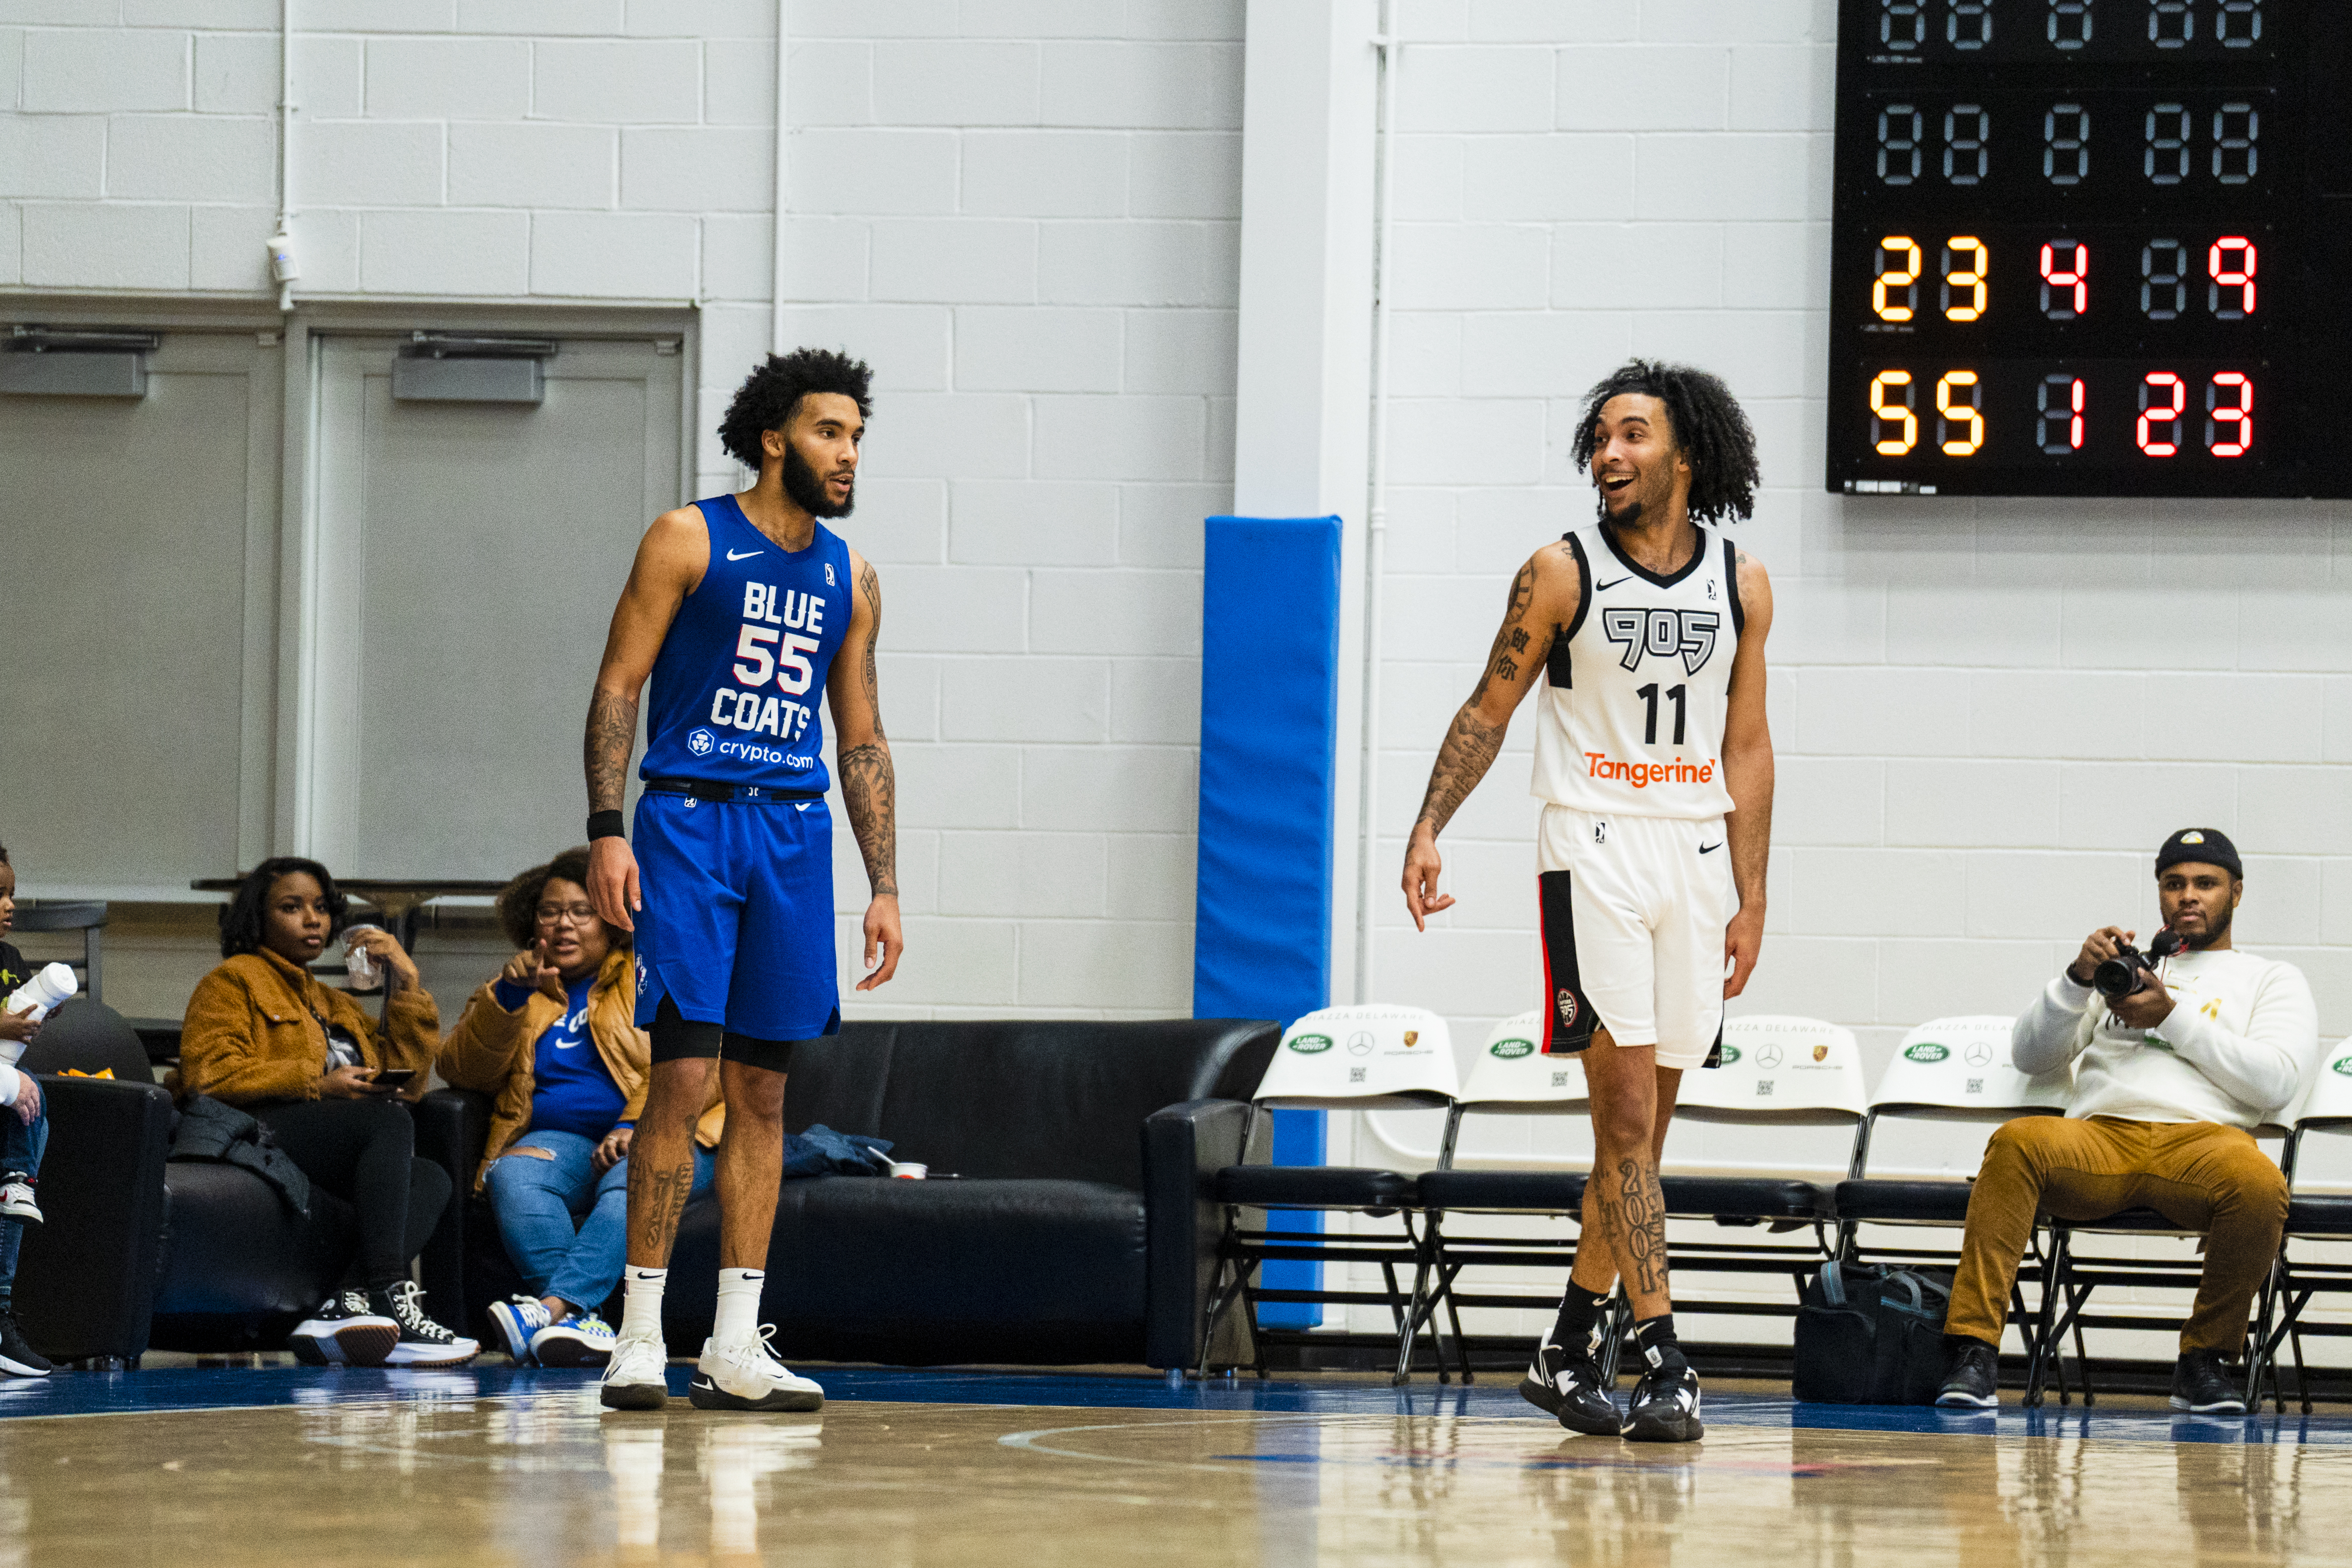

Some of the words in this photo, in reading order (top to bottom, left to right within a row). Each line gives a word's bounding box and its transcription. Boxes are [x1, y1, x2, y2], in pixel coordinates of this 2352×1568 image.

[1873, 236, 1988, 321] 23
[2040, 243, 2088, 314] 4
[2208, 236, 2257, 314] 9
[1870, 371, 1984, 456] 55
[2137, 372, 2253, 457] 23
[743, 581, 826, 634] BLUE
[733, 624, 820, 696] 55
[1603, 608, 1720, 677] 905
[710, 687, 811, 742] COATS
[1636, 683, 1686, 745] 11
[719, 739, 814, 769] crypto.com
[1584, 752, 1713, 788] Tangerine
[1305, 1012, 1349, 1021] PIAZZA
[1356, 1012, 1424, 1020] DELAWARE
[1506, 1017, 1541, 1026] PIAZZ
[1766, 1024, 1835, 1034] DELAWARE
[1618, 1158, 1657, 1295] 2001
